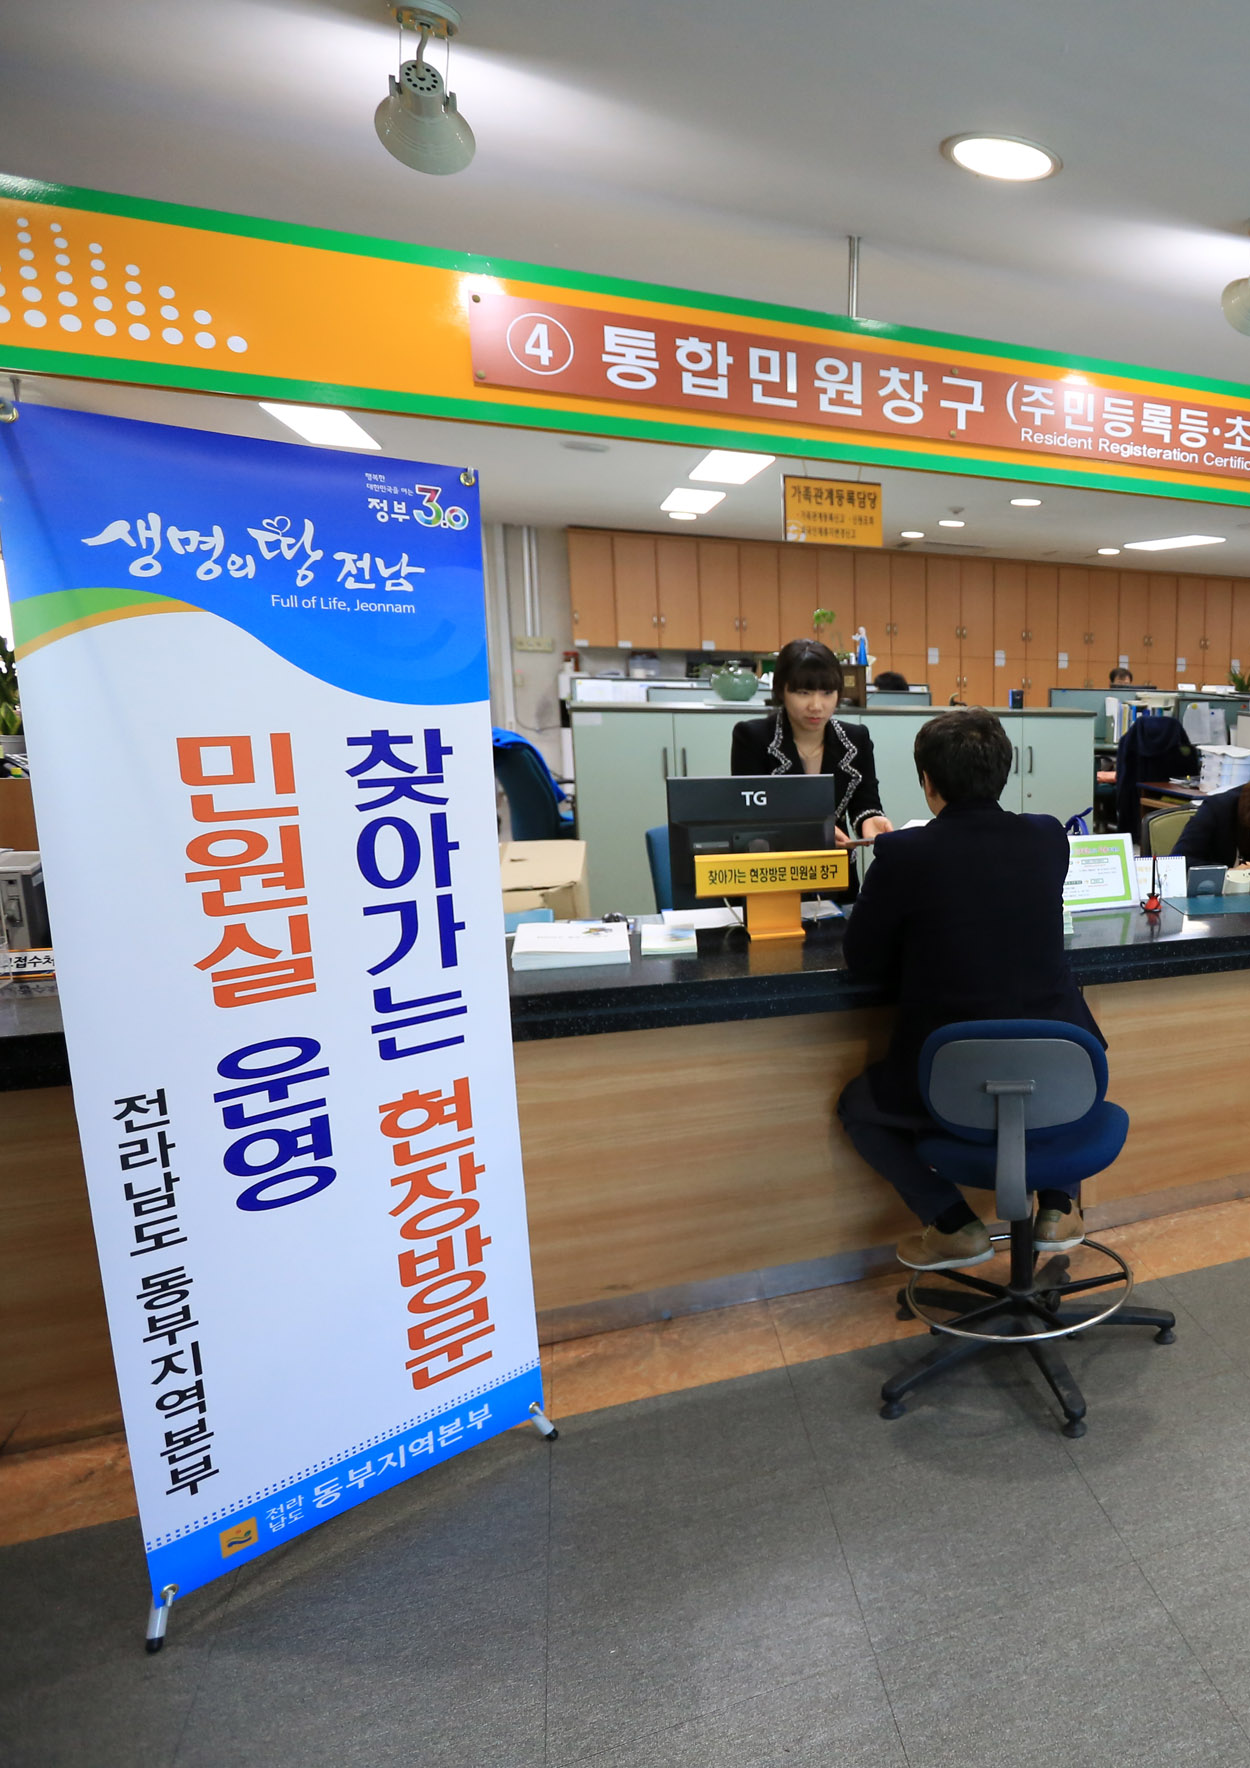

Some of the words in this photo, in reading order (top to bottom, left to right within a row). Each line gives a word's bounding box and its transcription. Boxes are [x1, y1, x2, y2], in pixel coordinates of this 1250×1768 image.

[601, 324, 985, 430] 통합민원창구
[1021, 427, 1093, 452] Resident
[1098, 437, 1198, 464] Registeration
[82, 512, 255, 580] 생명의
[335, 551, 425, 592] 전남
[367, 497, 410, 522] 정부
[412, 484, 469, 530] 3.0
[271, 594, 298, 608] Full
[302, 595, 317, 609] of
[320, 596, 351, 613] Life,
[353, 598, 415, 614] Jeonnam
[741, 791, 767, 806] TG
[176, 732, 317, 1009] 민원실
[345, 728, 468, 1061] 찾아가는
[708, 869, 746, 885] 찾아가는
[750, 866, 787, 883] 현장방문
[790, 865, 817, 881] 민원실
[820, 864, 838, 879] 창구
[112, 1088, 188, 1257] 전라남도
[213, 1036, 337, 1212] 운영
[378, 1076, 496, 1390] 현장방문
[136, 1266, 220, 1496] 동부지역본부
[312, 1403, 493, 1510] 동부지역본부
